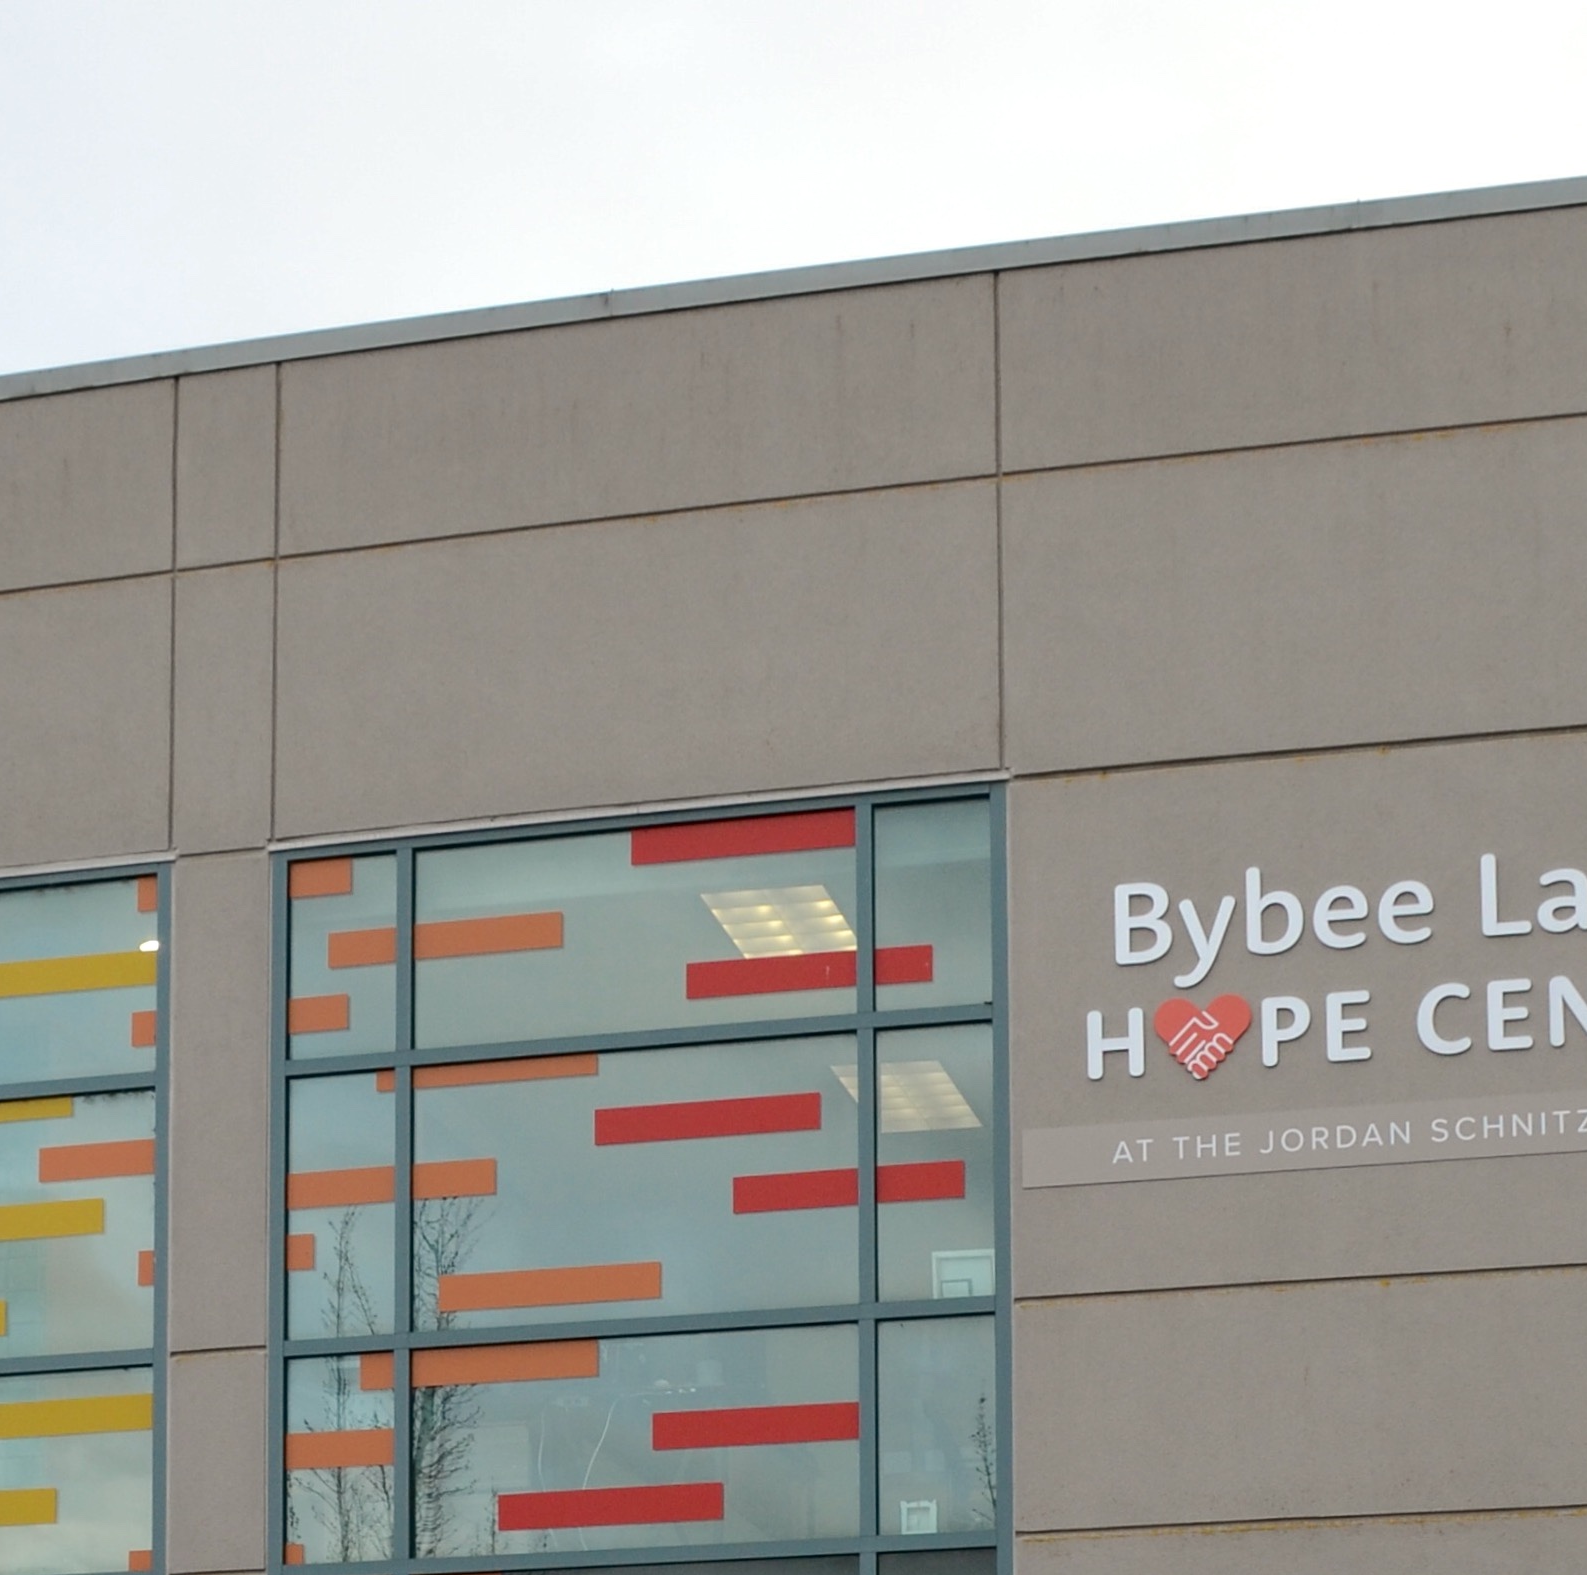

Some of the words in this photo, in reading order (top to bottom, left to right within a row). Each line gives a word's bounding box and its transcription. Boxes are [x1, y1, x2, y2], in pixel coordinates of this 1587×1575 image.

[1112, 866, 1435, 989] Bybee
[1111, 1138, 1154, 1164] AT
[1172, 1133, 1242, 1160] THE
[1259, 1121, 1412, 1154] JORDAN
